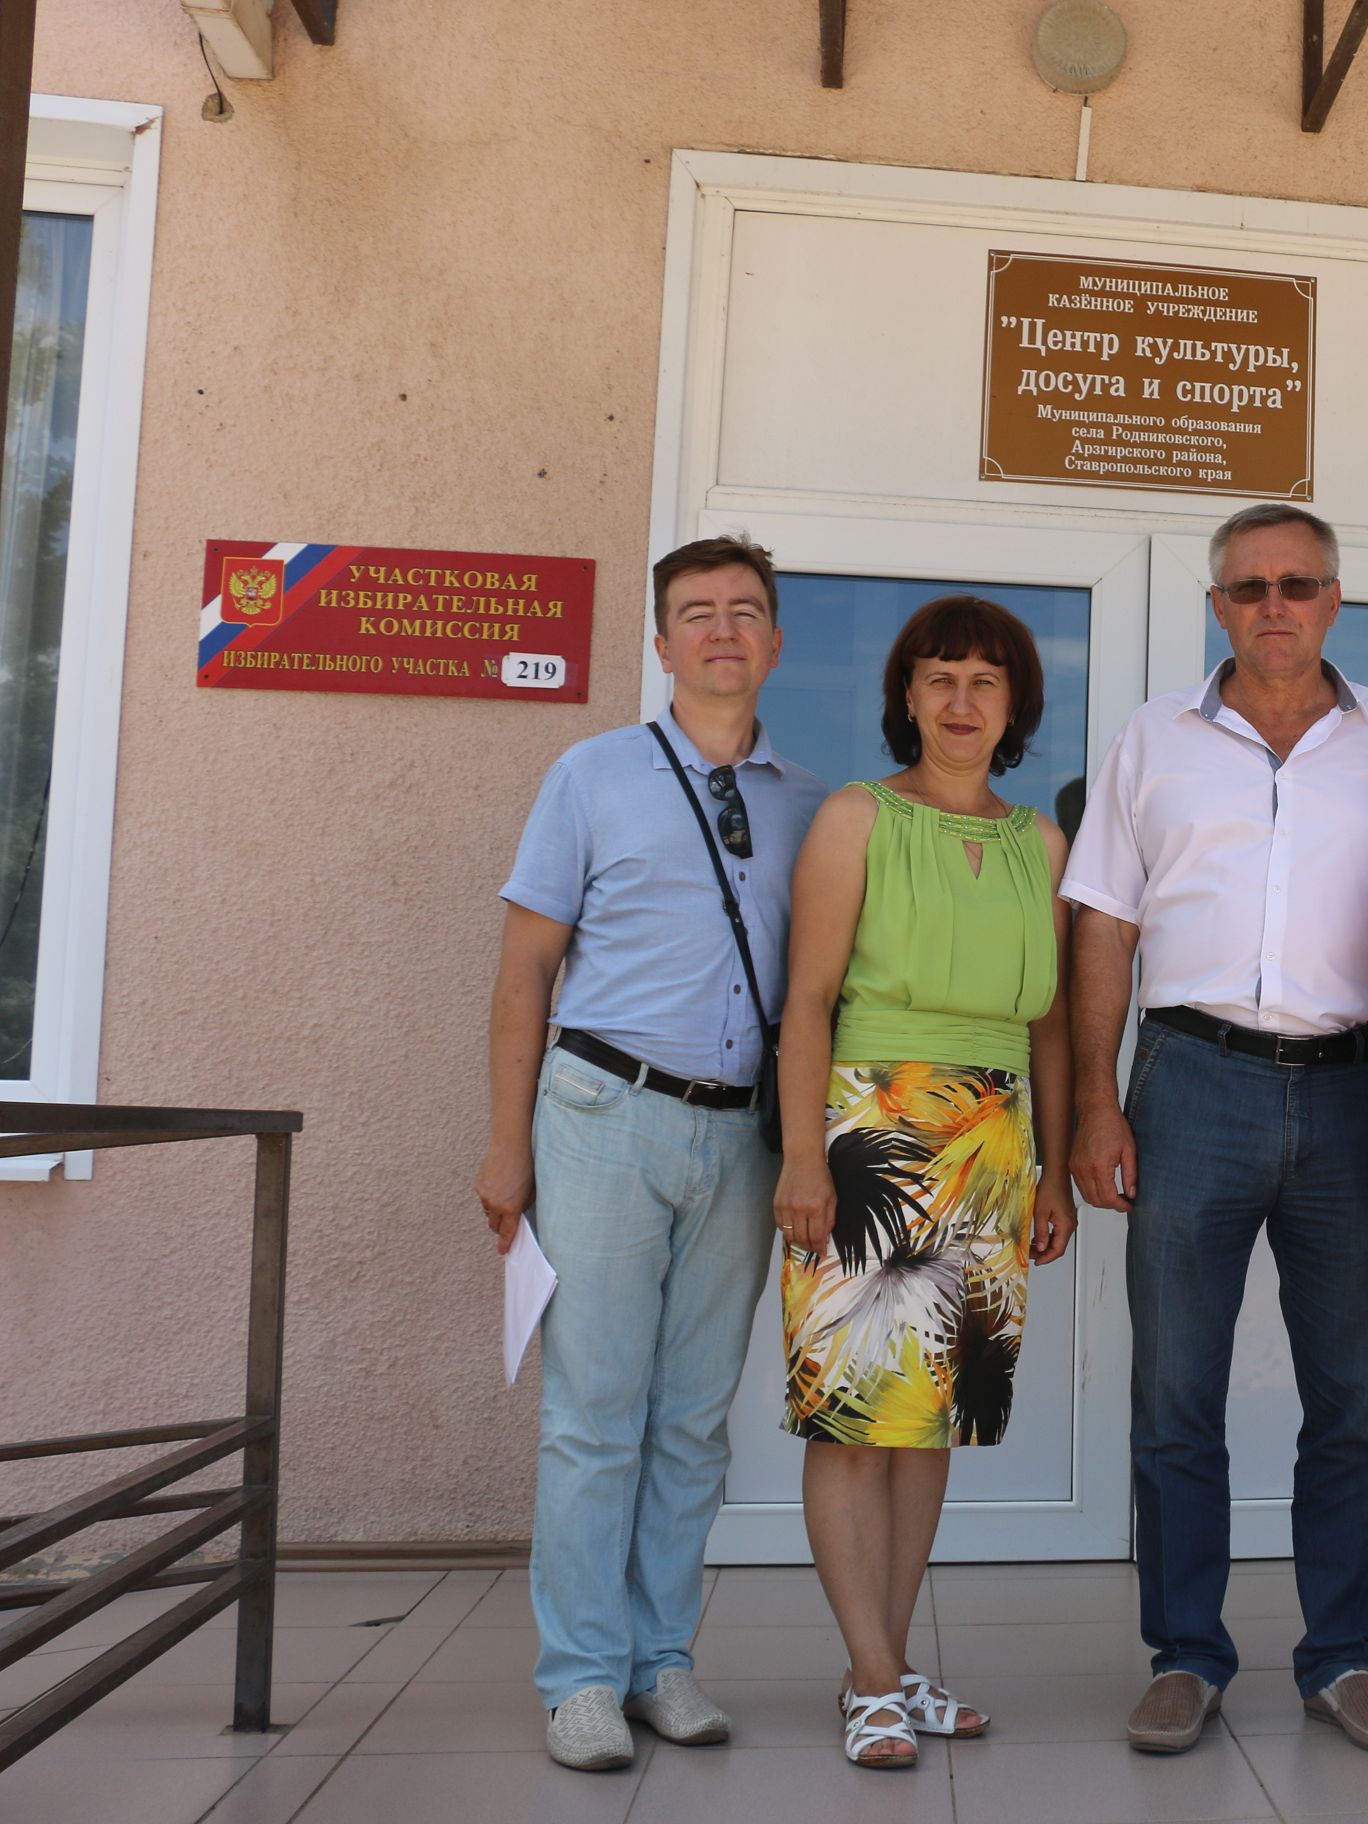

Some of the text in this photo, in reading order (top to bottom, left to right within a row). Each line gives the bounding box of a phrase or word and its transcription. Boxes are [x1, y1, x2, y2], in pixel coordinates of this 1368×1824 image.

[1079, 276, 1228, 301] МУНИЦИПАЛЬНОЕ
[1048, 293, 1258, 323] КАЗЁННОЕ УЧРЕЖДЕНИЕ
[1135, 335, 1298, 373] культуры,
[1018, 369, 1125, 400] досуга
[1142, 378, 1160, 399] и
[1037, 405, 1261, 434] Муниципального образования
[1072, 427, 1226, 449] села Родниковского,
[1072, 440, 1226, 465] Арзгирского района,
[1064, 456, 1232, 481] Ставропольского края
[349, 565, 537, 592] УЧАСТКОВАЯ
[319, 589, 564, 618] ИЗБИРАТЕЛЬНАЯ
[359, 617, 520, 641] КОМИССИЯ
[222, 650, 557, 681] ИЗБИРАТЕЛЬНОГО УЧАСТКА № 219
